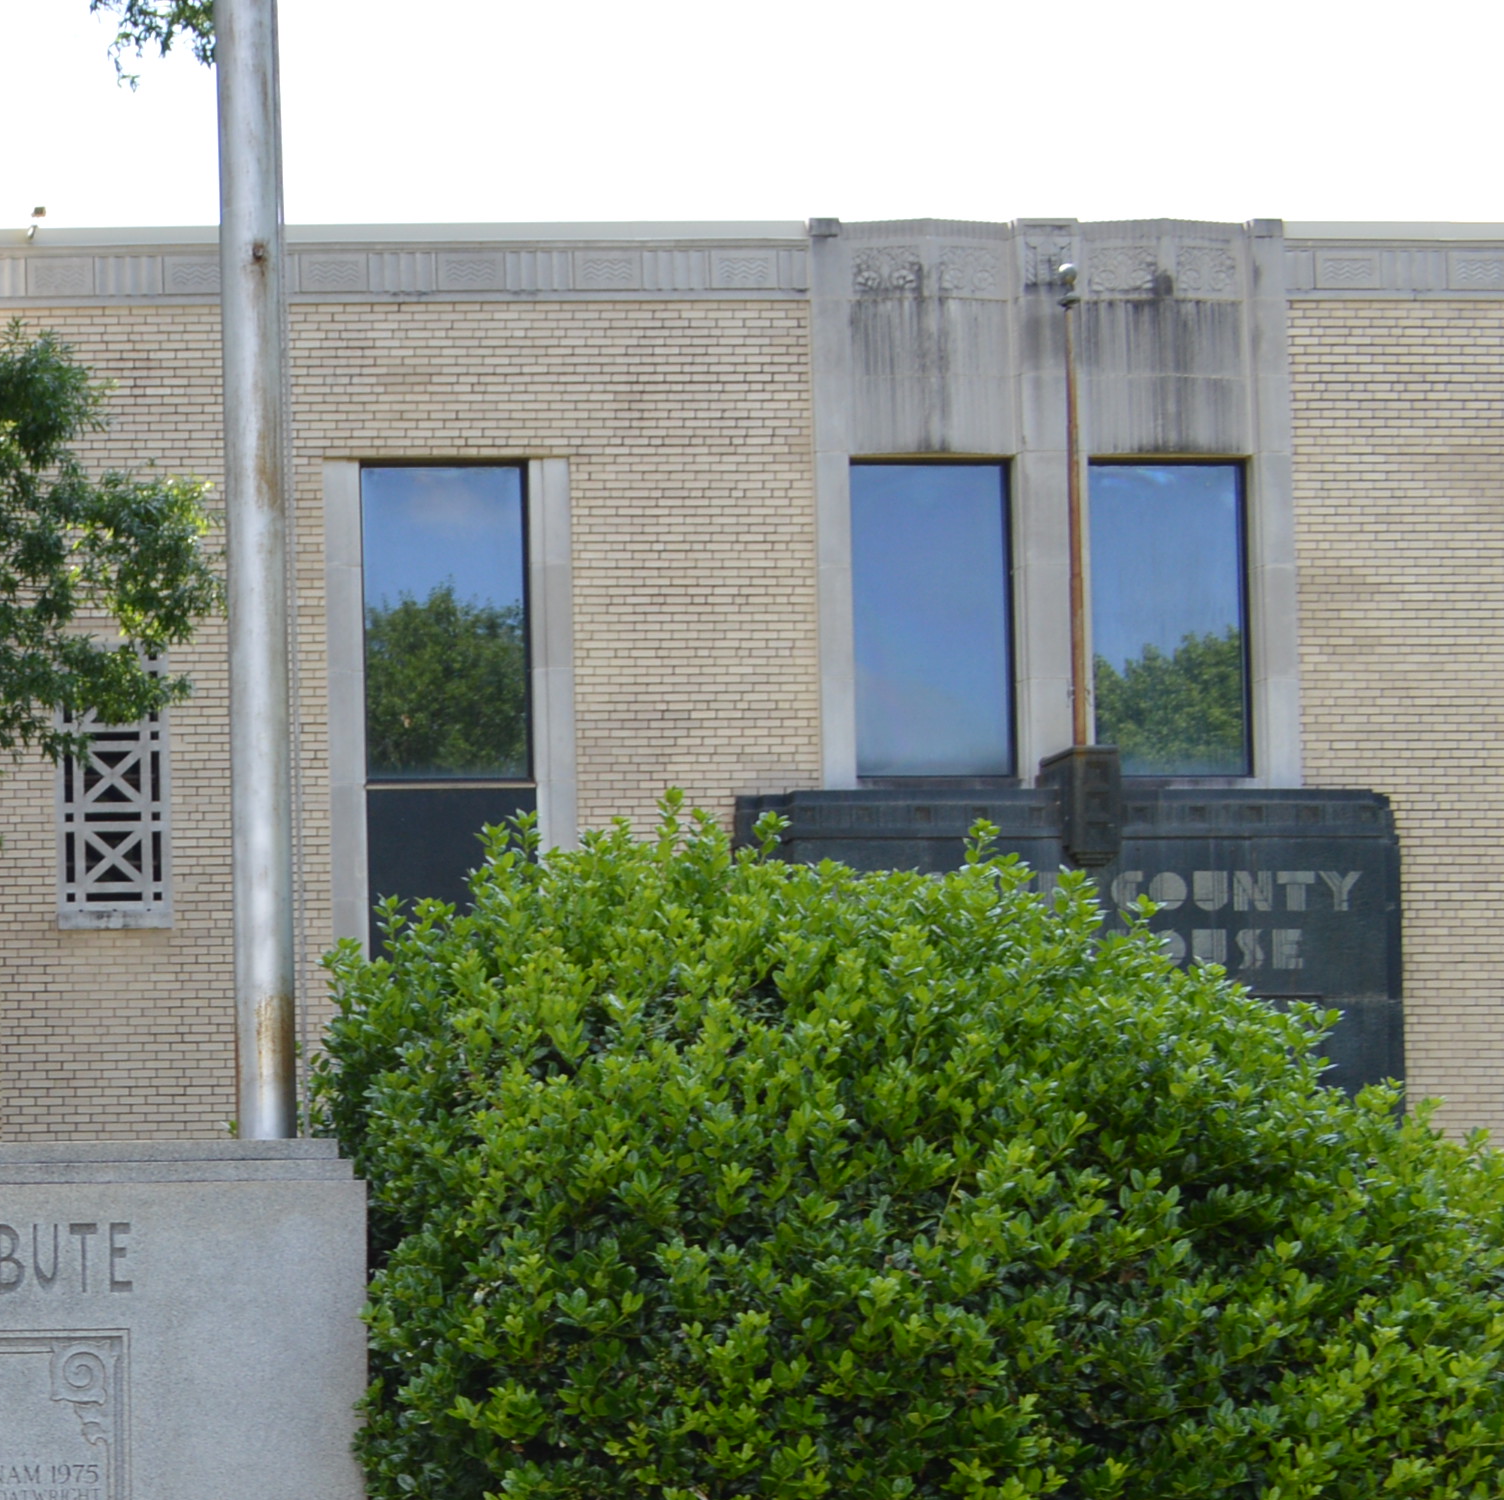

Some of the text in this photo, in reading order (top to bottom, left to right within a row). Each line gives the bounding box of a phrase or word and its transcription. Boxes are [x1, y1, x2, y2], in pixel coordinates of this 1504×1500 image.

[1111, 871, 1362, 911] COUNTY
[1157, 929, 1304, 969] OUSE
[51, 1464, 98, 1484] 1975
